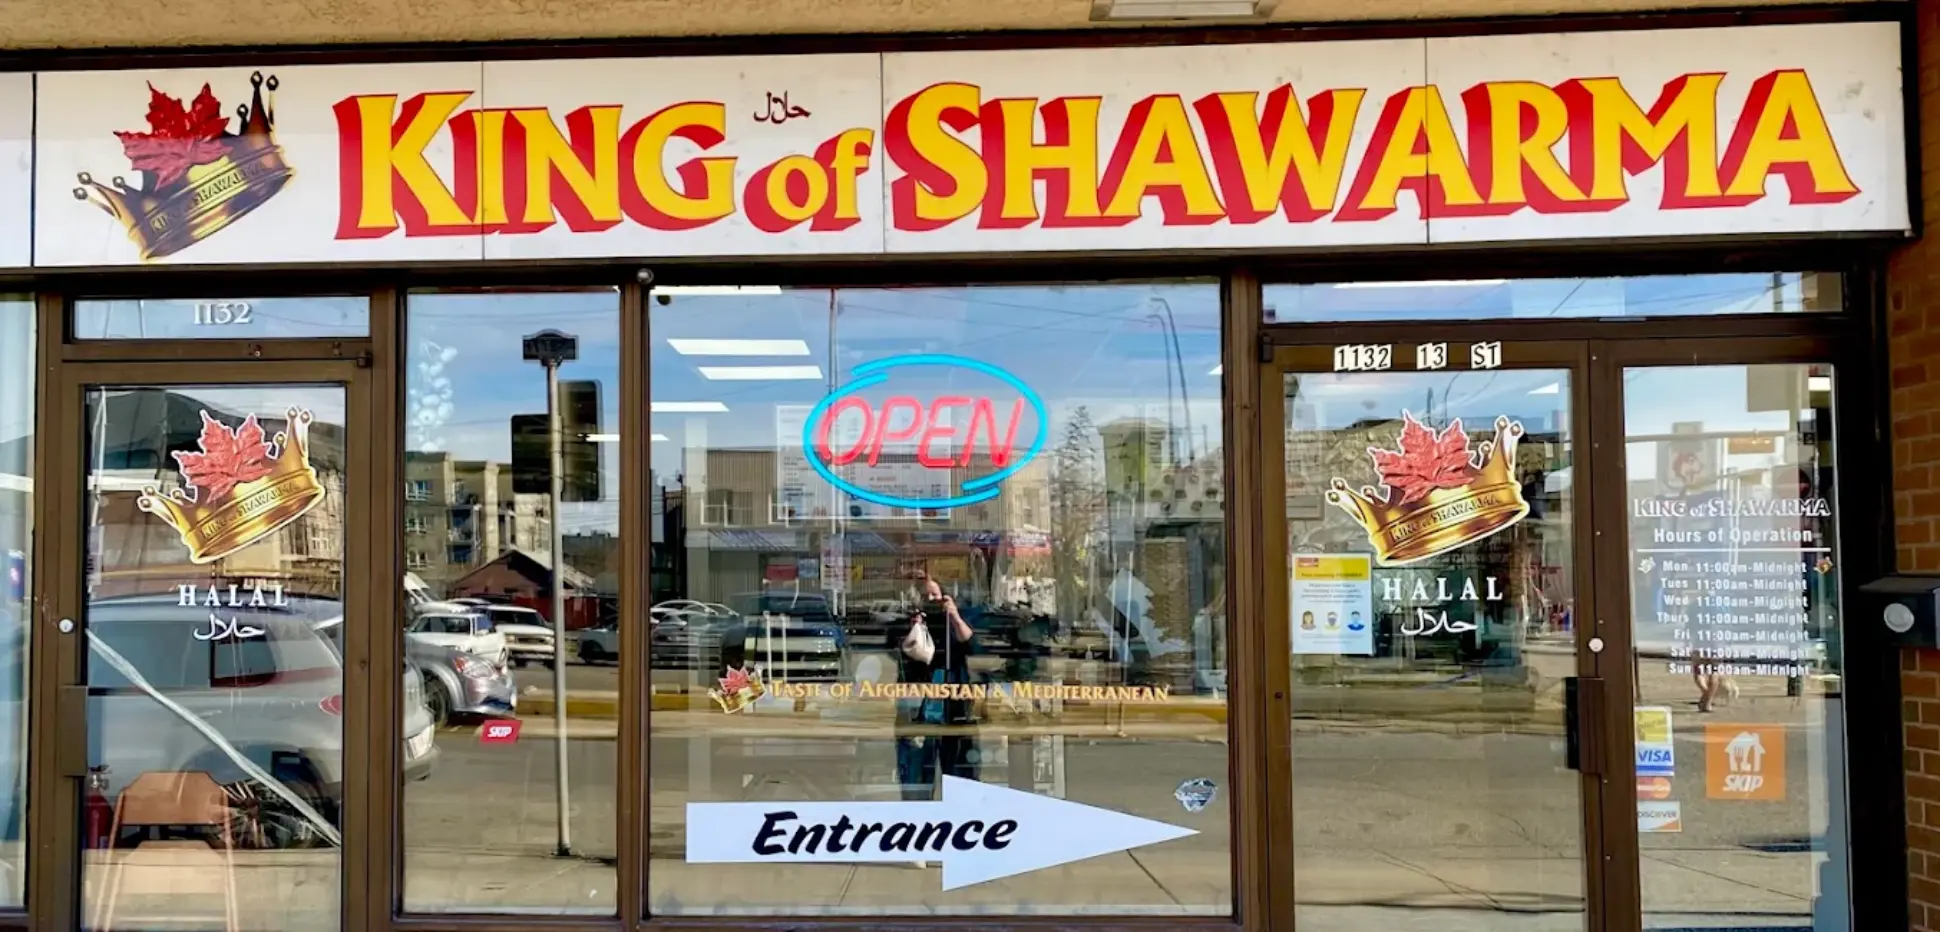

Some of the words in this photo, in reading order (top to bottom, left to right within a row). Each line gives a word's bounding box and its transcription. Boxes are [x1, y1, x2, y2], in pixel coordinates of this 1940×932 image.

[753, 91, 811, 124] حلال
[333, 90, 737, 240] KING
[743, 128, 875, 233] of
[883, 68, 1861, 232] SHAWARMA
[193, 301, 254, 325] 1132
[1336, 346, 1391, 370] 1132
[1419, 344, 1445, 367] 13
[1472, 343, 1499, 367] ST
[818, 394, 1025, 469] OPEN
[1633, 498, 1687, 517] KING
[1708, 498, 1831, 517] SHAWARMA
[1653, 528, 1702, 543] Hours
[1707, 528, 1725, 543] of
[1729, 527, 1813, 545] Operation
[1662, 560, 1689, 573] Mon
[1381, 576, 1503, 601] HALAL
[1660, 577, 1689, 589] Tues
[178, 584, 287, 607] HALAL
[1663, 594, 1689, 607] Wed
[193, 613, 265, 640] حلال
[1400, 607, 1478, 636] حلال
[1656, 611, 1690, 625] Thurs
[1673, 629, 1691, 640] Fri
[1670, 646, 1692, 657] Sat
[1669, 663, 1692, 674] Sun
[770, 680, 821, 698] TASTE
[859, 680, 986, 699] AFGHANISTAN
[992, 682, 1007, 699] &
[1012, 681, 1170, 701] MEDITERRANEAN
[487, 726, 513, 738] SKIP
[1638, 750, 1672, 762] VISA
[1722, 775, 1764, 792] SKIP
[751, 810, 1018, 857] Entrance
